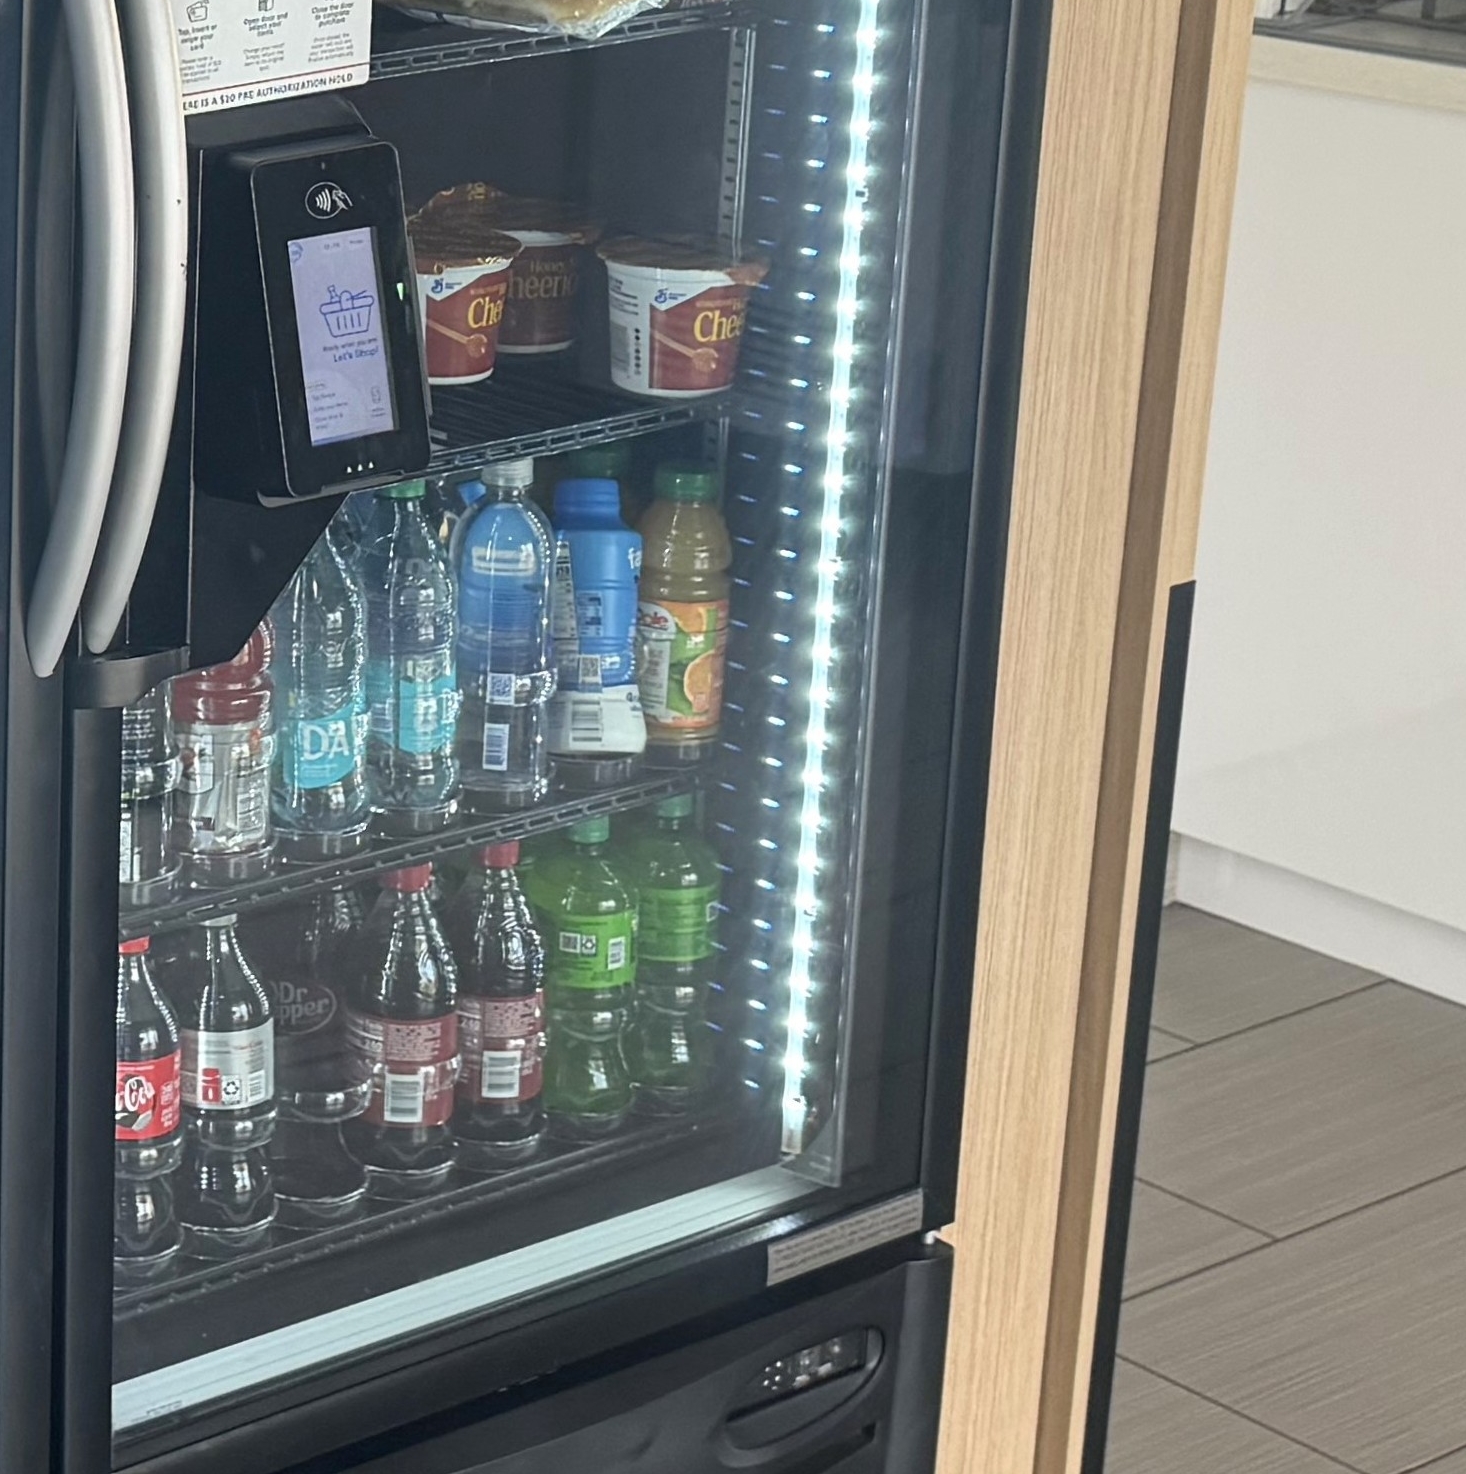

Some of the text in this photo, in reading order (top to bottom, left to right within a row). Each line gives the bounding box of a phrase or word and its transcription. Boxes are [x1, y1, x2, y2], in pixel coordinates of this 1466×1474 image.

[201, 74, 353, 108] IS A $20 PRE AUTHORIZATION HOLD
[280, 982, 308, 1003] Dr
